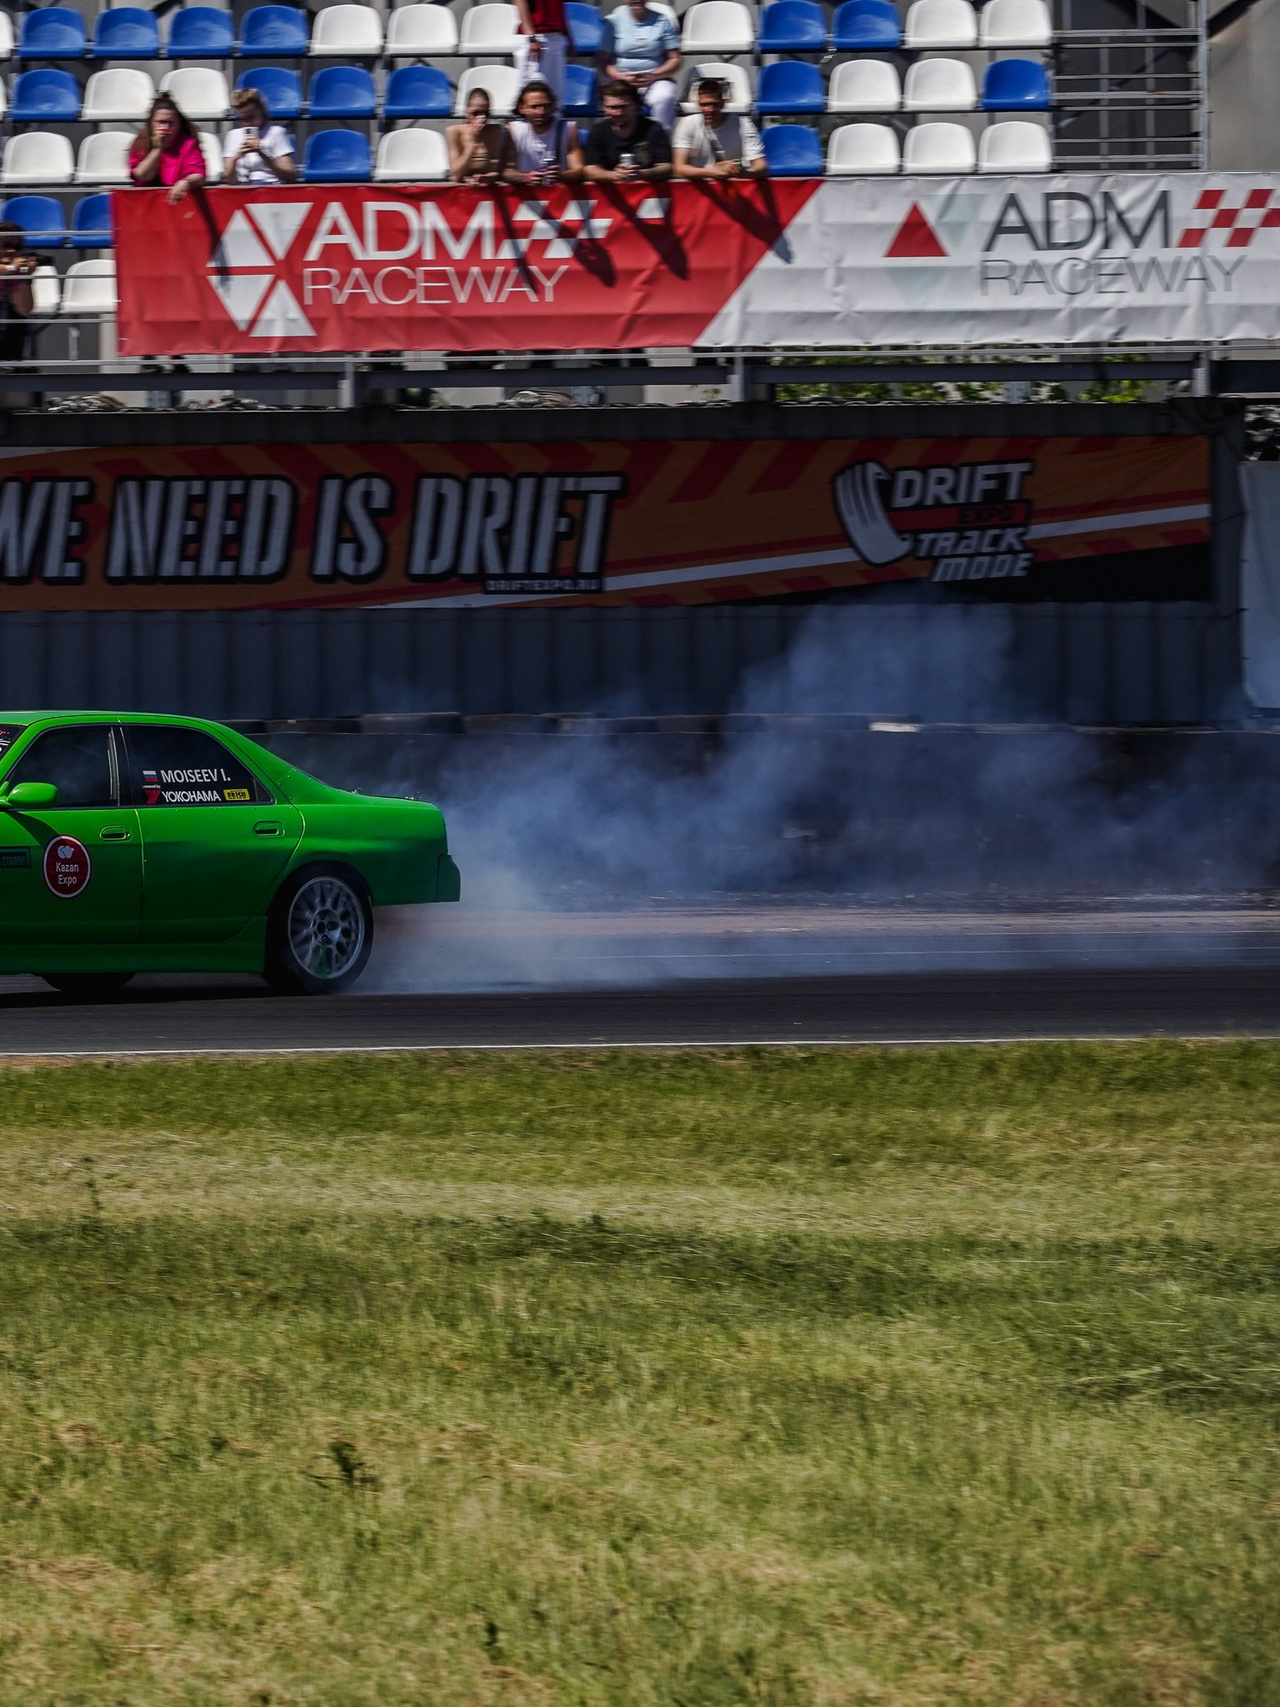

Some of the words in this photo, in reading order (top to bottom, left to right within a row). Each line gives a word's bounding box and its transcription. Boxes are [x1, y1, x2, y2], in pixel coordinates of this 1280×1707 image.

[303, 201, 494, 261] ADM
[984, 190, 1170, 252] ADM
[303, 265, 570, 305] RACEWAY
[980, 254, 1247, 297] RACEWAY
[890, 462, 1032, 507] DRIFT
[106, 477, 293, 579] NEED
[313, 476, 390, 577] IS
[408, 475, 623, 576] DRIFT
[957, 504, 1016, 524] EXPO
[160, 768, 218, 783] MOISEEV
[161, 790, 222, 803] YOKOHAMA
[55, 862, 80, 873] Kazan
[57, 874, 78, 887] Expo
